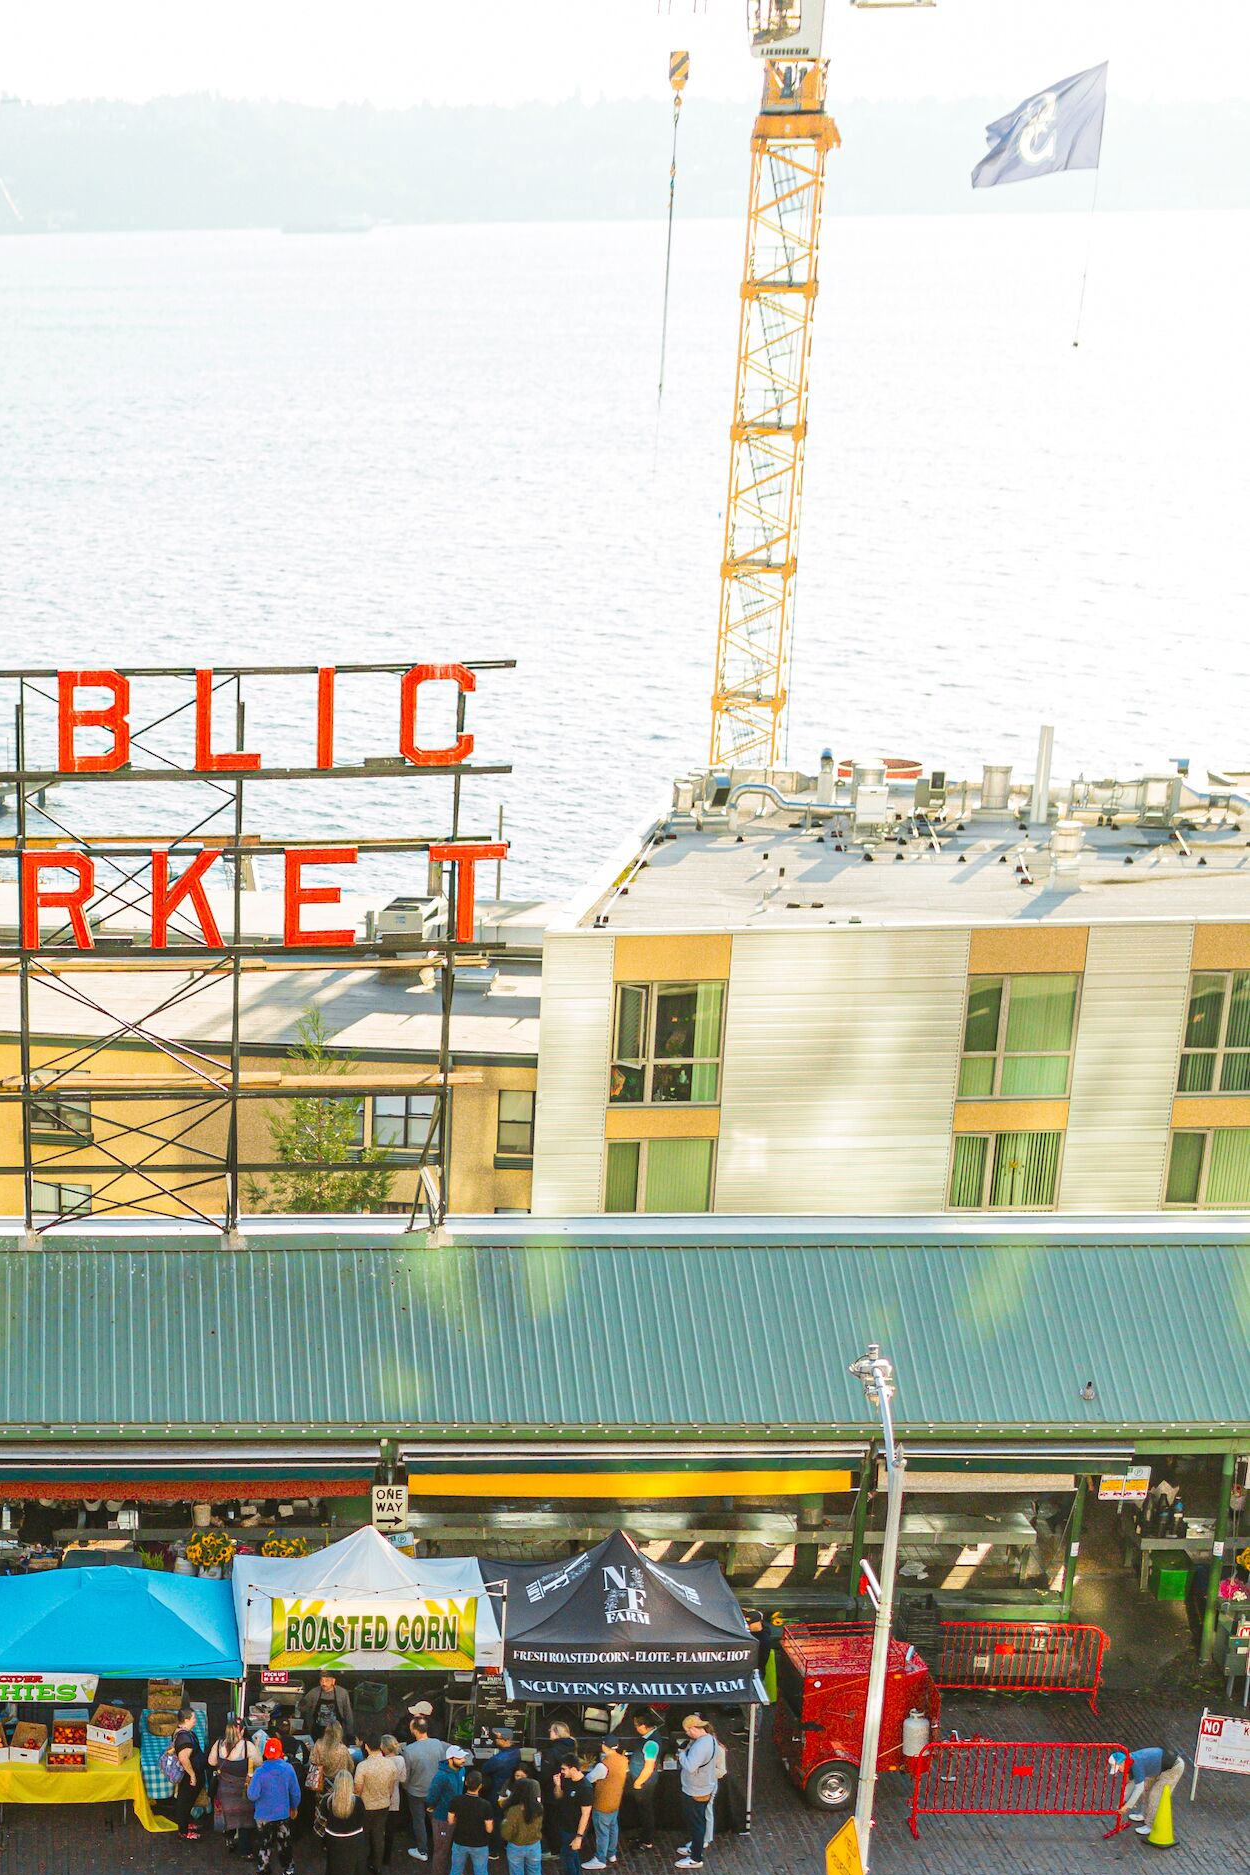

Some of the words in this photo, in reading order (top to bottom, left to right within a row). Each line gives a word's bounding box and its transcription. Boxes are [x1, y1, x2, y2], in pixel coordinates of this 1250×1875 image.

[376, 1489, 403, 1499] ONE
[376, 1503, 403, 1512] WAY
[606, 1612, 651, 1625] FARM
[285, 1614, 389, 1652] ROASTED
[395, 1614, 459, 1652] CORN
[513, 1650, 548, 1662] FRESH
[549, 1651, 599, 1663] ROASTED
[599, 1651, 630, 1663] CORN
[636, 1651, 670, 1663] ELOTE
[676, 1650, 726, 1663] FLAMING
[726, 1650, 751, 1661] HOT
[518, 1680, 616, 1696] NGUYEN'S
[618, 1682, 689, 1696] FAMILY
[690, 1678, 747, 1695] FARM
[1204, 1720, 1220, 1734] NO
